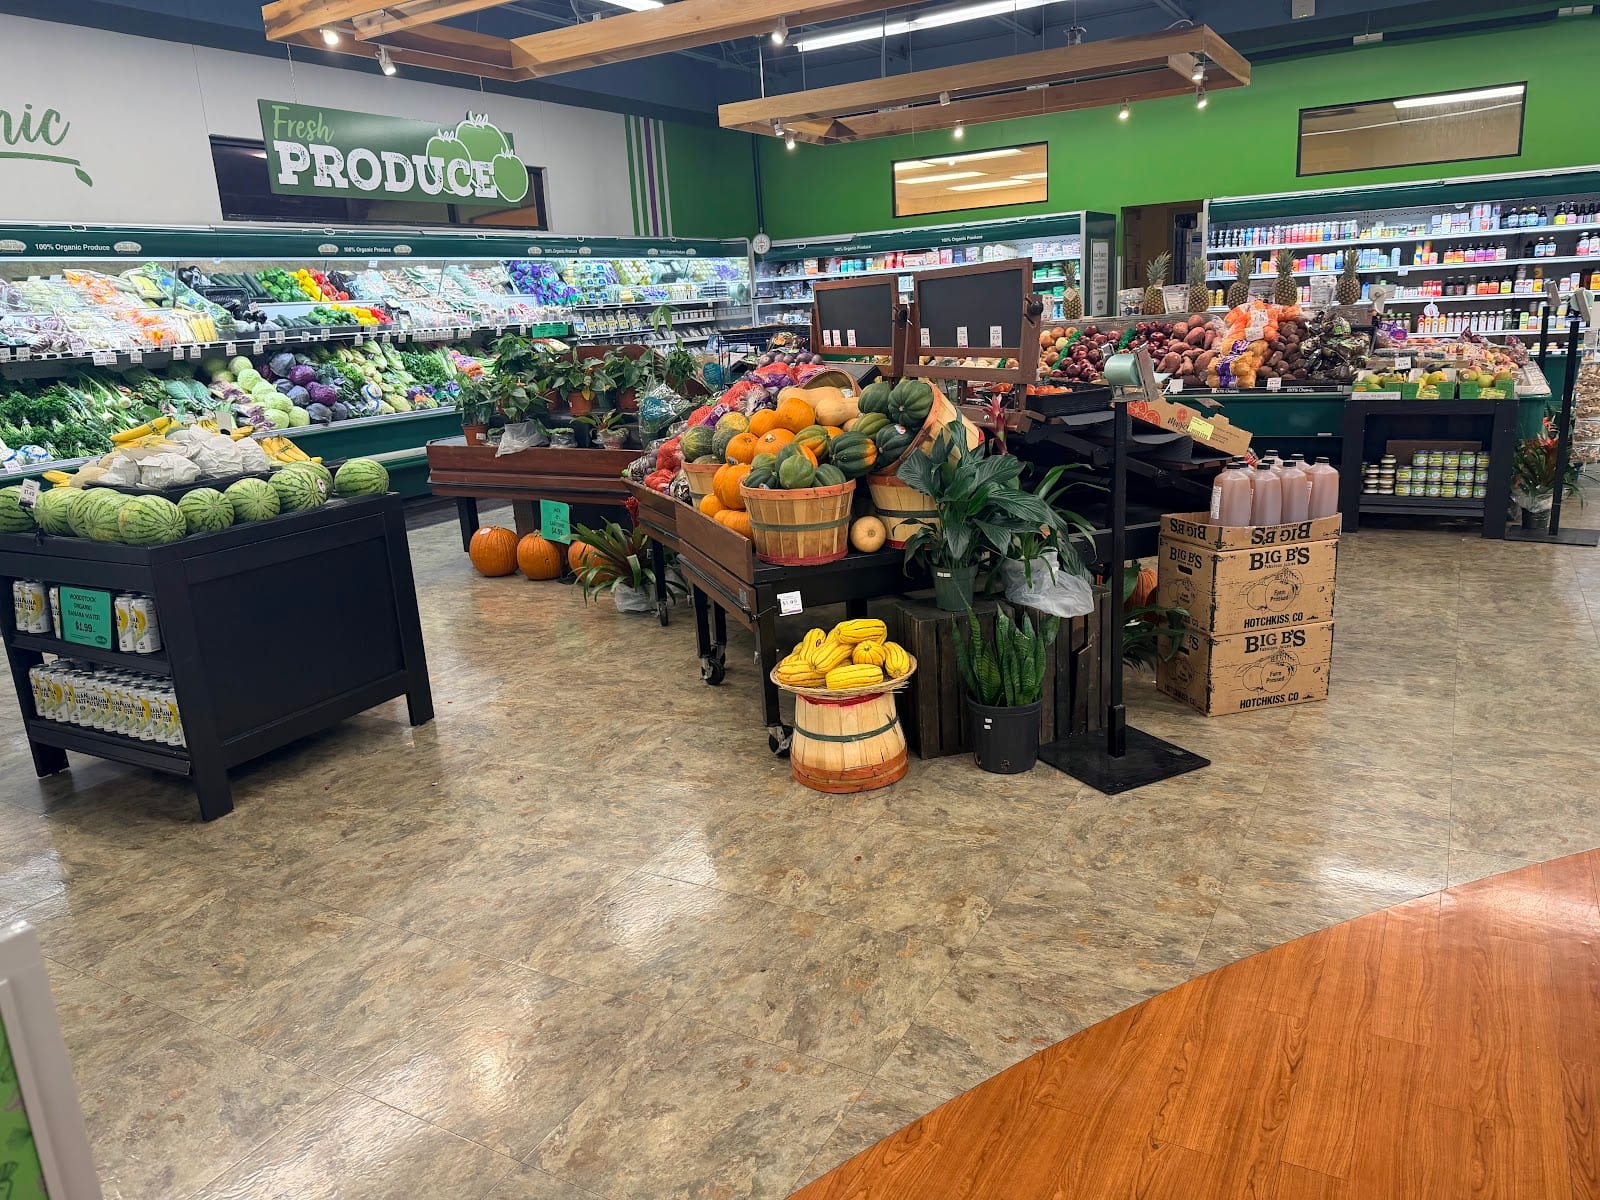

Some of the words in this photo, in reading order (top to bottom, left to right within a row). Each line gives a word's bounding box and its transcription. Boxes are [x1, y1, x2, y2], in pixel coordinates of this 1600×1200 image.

[272, 105, 335, 143] Fresh
[273, 140, 498, 198] PRODUCE
[55, 244, 82, 252] Organic
[1187, 525, 1207, 541] BIG
[1251, 527, 1276, 545] B'S
[1279, 521, 1313, 542] BIG
[1169, 547, 1187, 561] BIG
[1188, 551, 1202, 569] B'S
[1249, 550, 1282, 571] BIG
[1285, 546, 1310, 565] B'S
[1292, 612, 1304, 622] CO
[1244, 633, 1278, 653] BIG
[1281, 629, 1306, 647] B'S
[1288, 692, 1298, 701] CO
